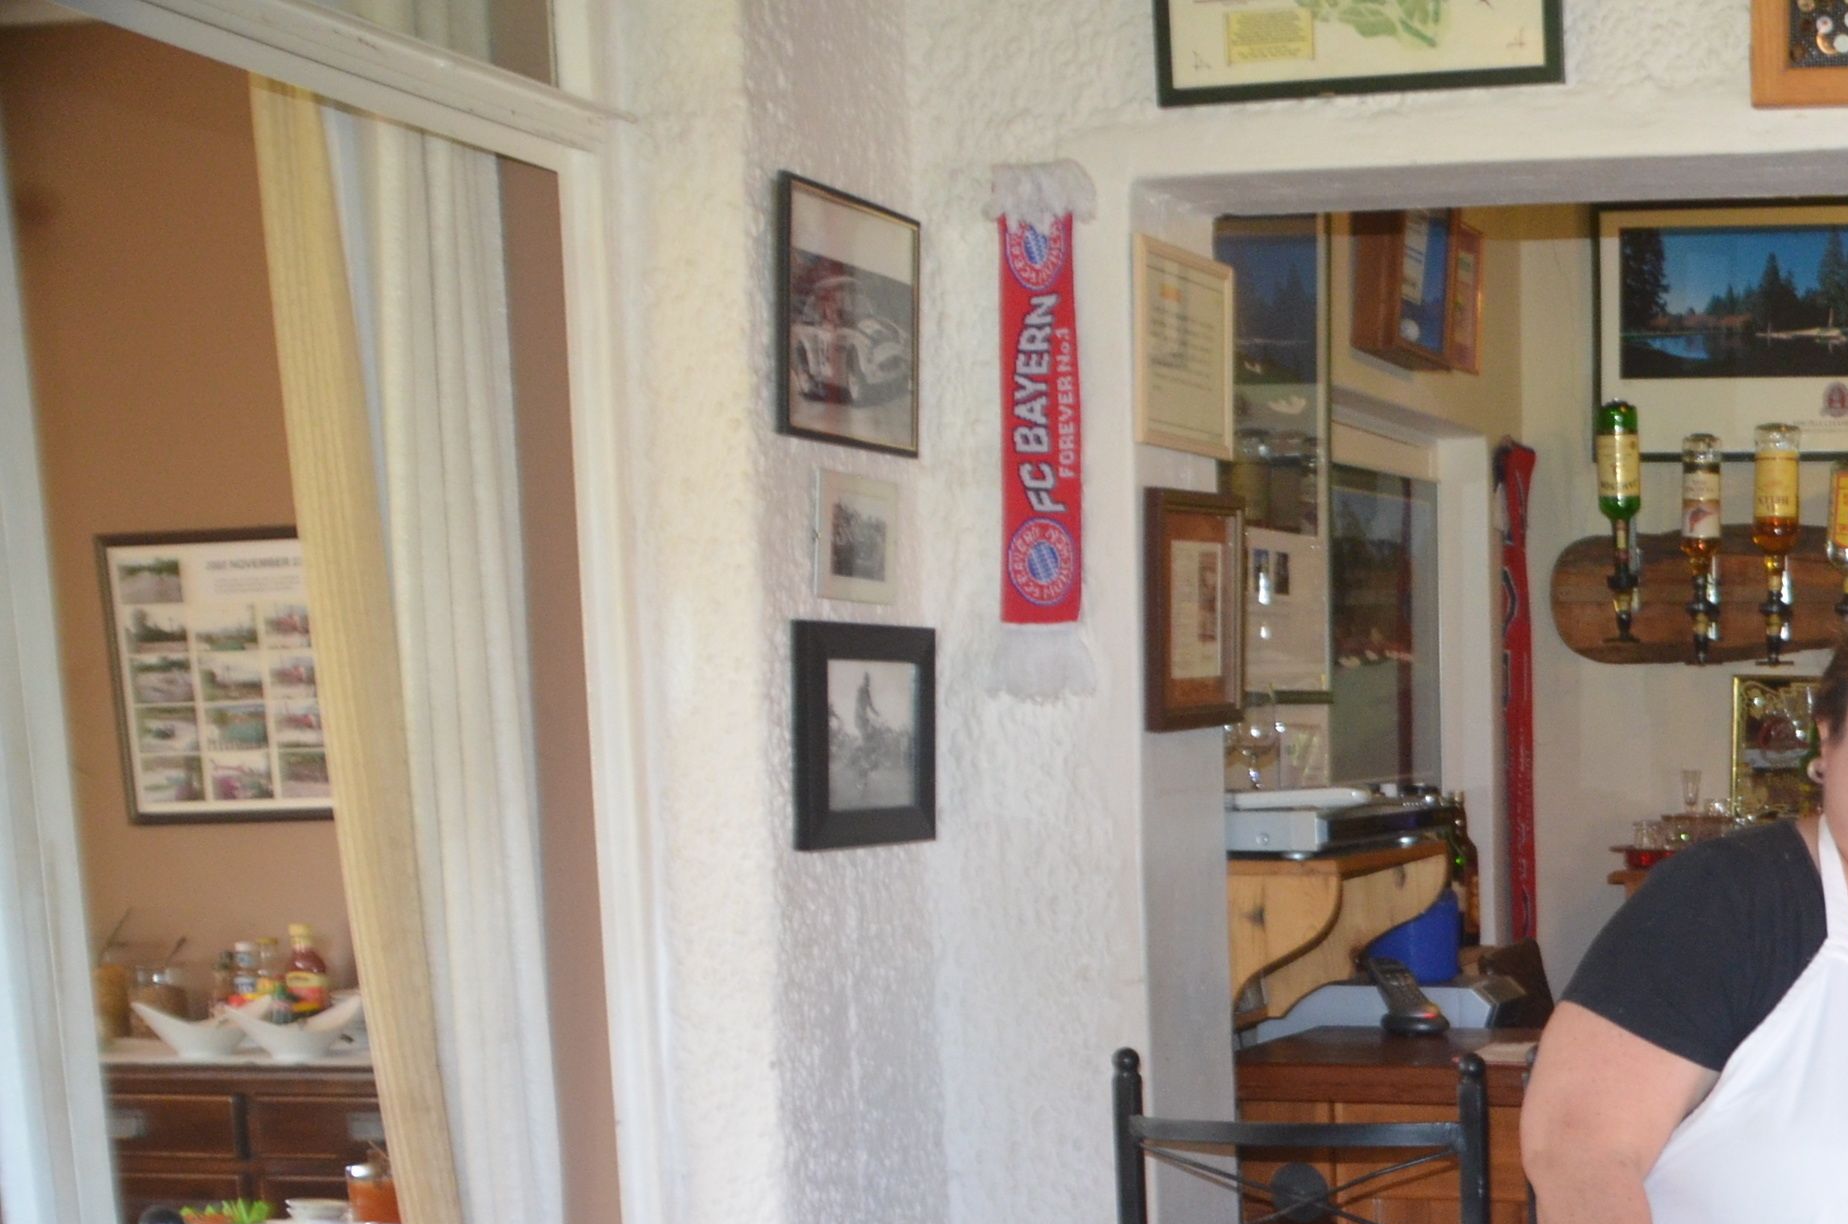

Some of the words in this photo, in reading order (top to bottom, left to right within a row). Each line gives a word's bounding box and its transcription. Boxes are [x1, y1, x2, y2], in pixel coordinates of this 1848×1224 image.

[1012, 293, 1058, 453] BAYERN
[1057, 376, 1076, 478] FOREVER
[1019, 462, 1066, 514] FC
